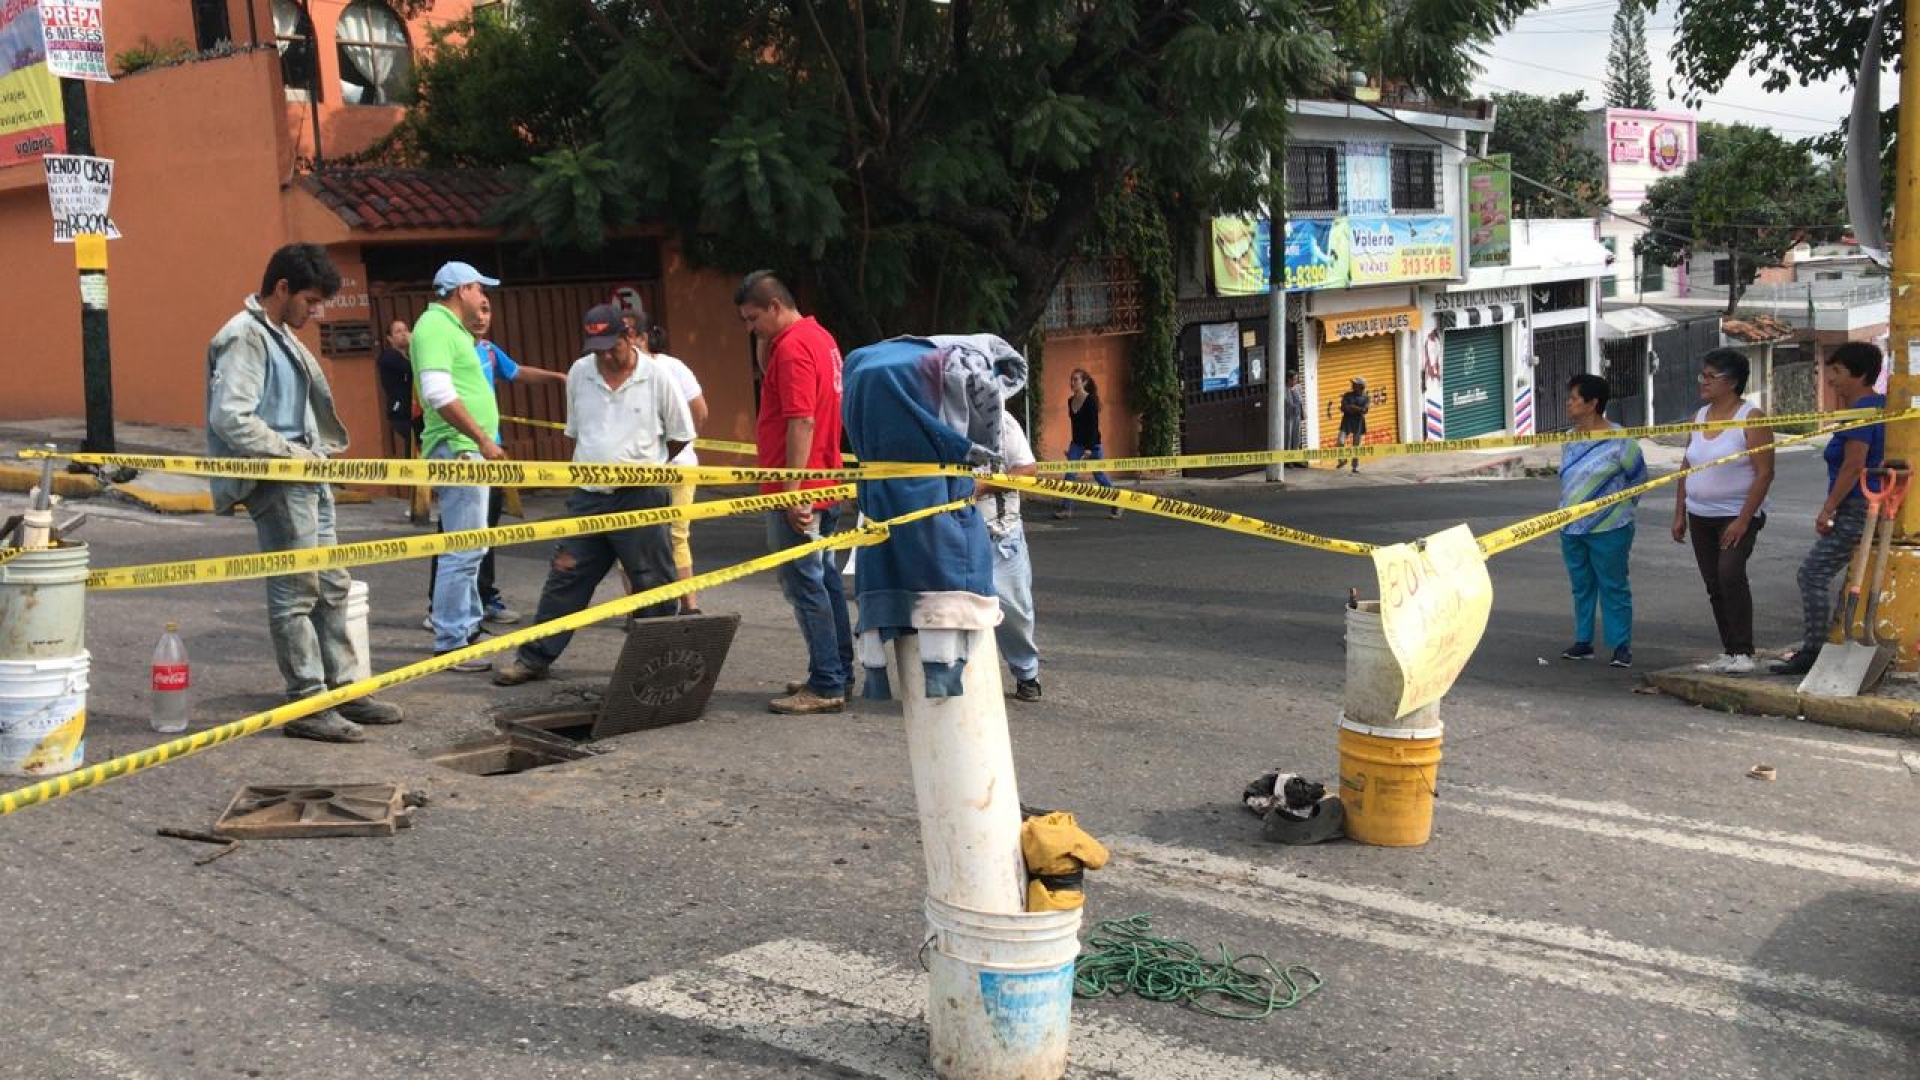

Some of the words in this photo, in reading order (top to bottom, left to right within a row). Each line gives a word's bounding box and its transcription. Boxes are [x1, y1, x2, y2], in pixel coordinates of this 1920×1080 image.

[43, 6, 101, 27] PREPA
[45, 27, 53, 40] 6
[56, 28, 102, 41] MESES
[15, 134, 55, 155] volaris
[44, 158, 81, 174] VENDO
[84, 160, 110, 185] CASA
[1352, 228, 1394, 248] Valeria
[1435, 291, 1486, 310] ESTETICA
[1336, 319, 1368, 337] AGENCIA
[1368, 318, 1378, 333] DE
[1378, 313, 1409, 332] VIAJES
[303, 461, 388, 481] PRECAUCION
[427, 463, 525, 484] PRECAUCION
[568, 465, 683, 485] PRECAUCION
